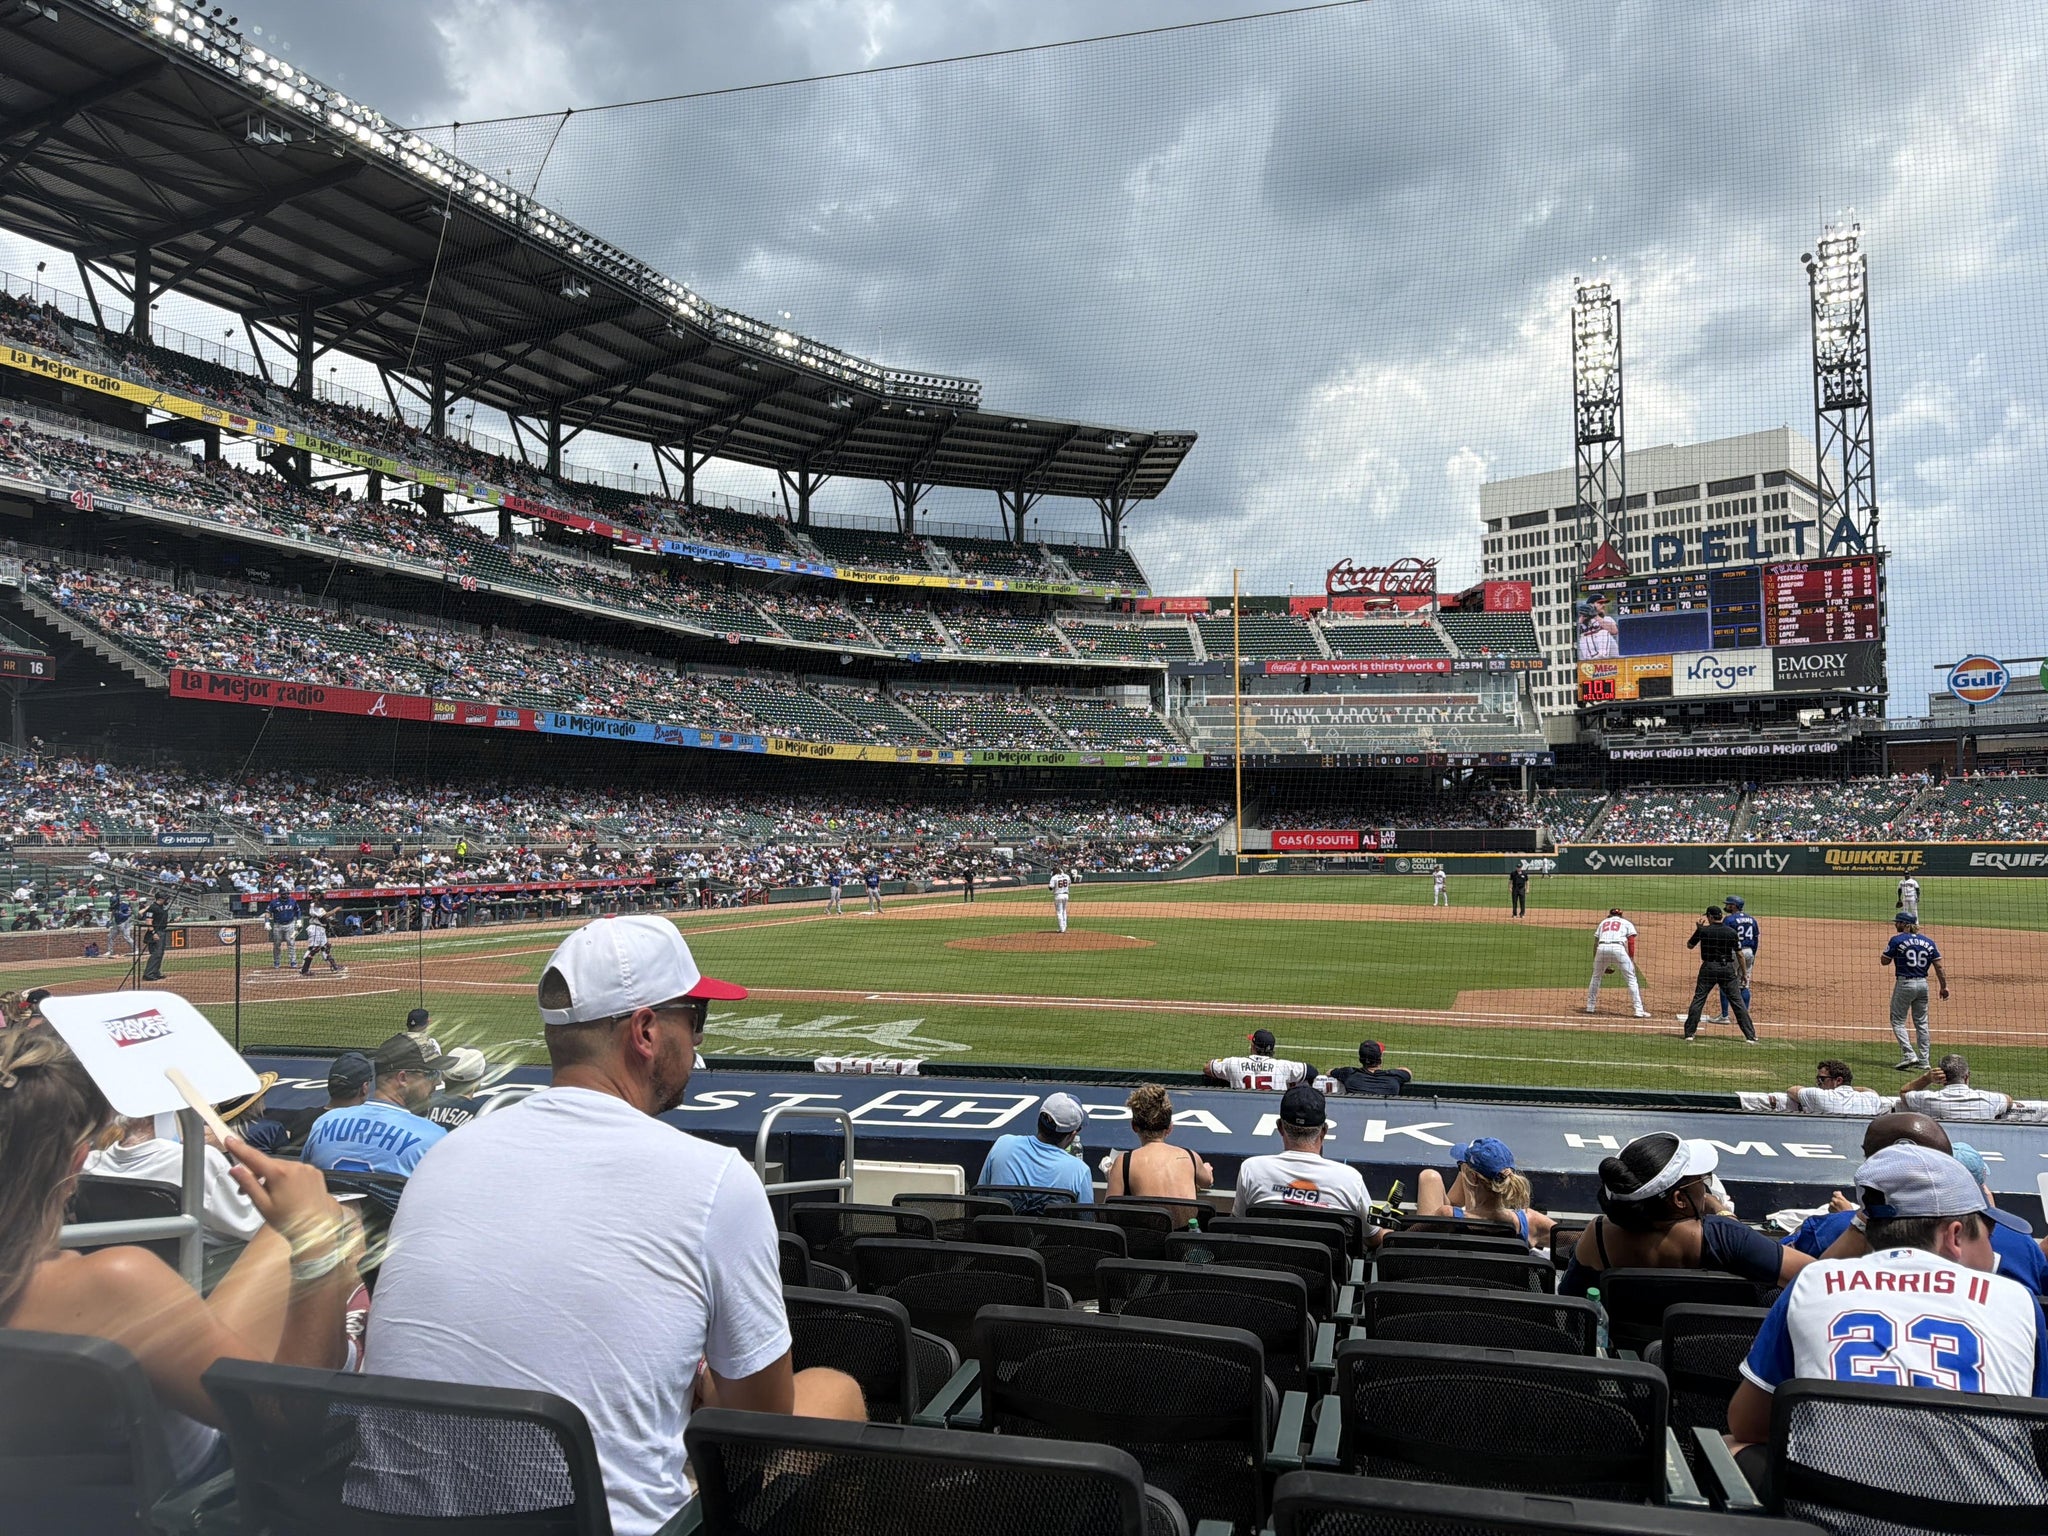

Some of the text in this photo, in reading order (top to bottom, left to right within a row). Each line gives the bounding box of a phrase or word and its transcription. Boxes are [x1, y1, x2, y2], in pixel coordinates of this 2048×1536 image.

[11, 350, 120, 391] La Mejor radio
[306, 437, 383, 467] La Mejor radio
[50, 490, 124, 512] EDDIE 41 MATHEWS
[514, 497, 570, 522] La Mejor radio
[671, 541, 730, 559] La Mejor radio
[1653, 517, 1866, 569] DELTA
[852, 572, 876, 583] Mejor
[878, 574, 900, 582] radio
[1326, 557, 1441, 594] Coca-Cola
[1770, 563, 1808, 575] TEXAS
[460, 575, 476, 592] 44
[1025, 583, 1048, 593] Mejor
[1051, 585, 1071, 593] radio
[1650, 604, 1660, 612] 46
[1768, 607, 1776, 616] 21
[726, 632, 741, 644] 47
[3, 660, 44, 675] HR 16
[1271, 662, 1297, 672] Coca-Cola
[1360, 662, 1369, 670] is
[1371, 662, 1404, 672] thirsty
[1594, 664, 1618, 672] MEGA
[1777, 653, 1848, 672] EMORY
[1688, 655, 1756, 689] Kroger
[1779, 670, 1845, 680] HEALTHCARE
[1952, 671, 2004, 688] Gulf
[180, 672, 325, 705] La Mejor radio
[434, 702, 456, 713] 1600
[1270, 706, 1488, 724] HANK AARON TERRACE
[554, 714, 636, 737] La Mejor radio
[775, 739, 834, 756] La Mejor radio
[1610, 748, 1681, 760] La Mejor radio
[1683, 745, 1758, 758] La Mejor radio
[1759, 742, 1838, 755] La Mejor radio
[983, 751, 1065, 764] La Mejor radio
[1279, 835, 1354, 845] GAS SOUTH
[1362, 835, 1377, 845] AL
[1609, 854, 1674, 868] Wellstar
[1708, 848, 1790, 873] xfinity
[1824, 849, 1924, 866] QUIKRETE
[1602, 921, 1621, 932] 28
[1738, 926, 1753, 940] 24
[171, 930, 185, 947] 16
[1906, 950, 1928, 968] 96
[104, 1015, 165, 1032] BRAVES
[108, 1022, 168, 1040] VISION
[1241, 1062, 1274, 1072] FARMER
[1243, 1076, 1272, 1090] 15
[428, 1107, 474, 1128] ANSO
[318, 1117, 422, 1156] MURPHY
[1563, 1133, 1847, 1160] HME
[1284, 1189, 1318, 1202] JSG
[1825, 1270, 1990, 1306] HARRIS II
[1828, 1309, 1986, 1393] 23
